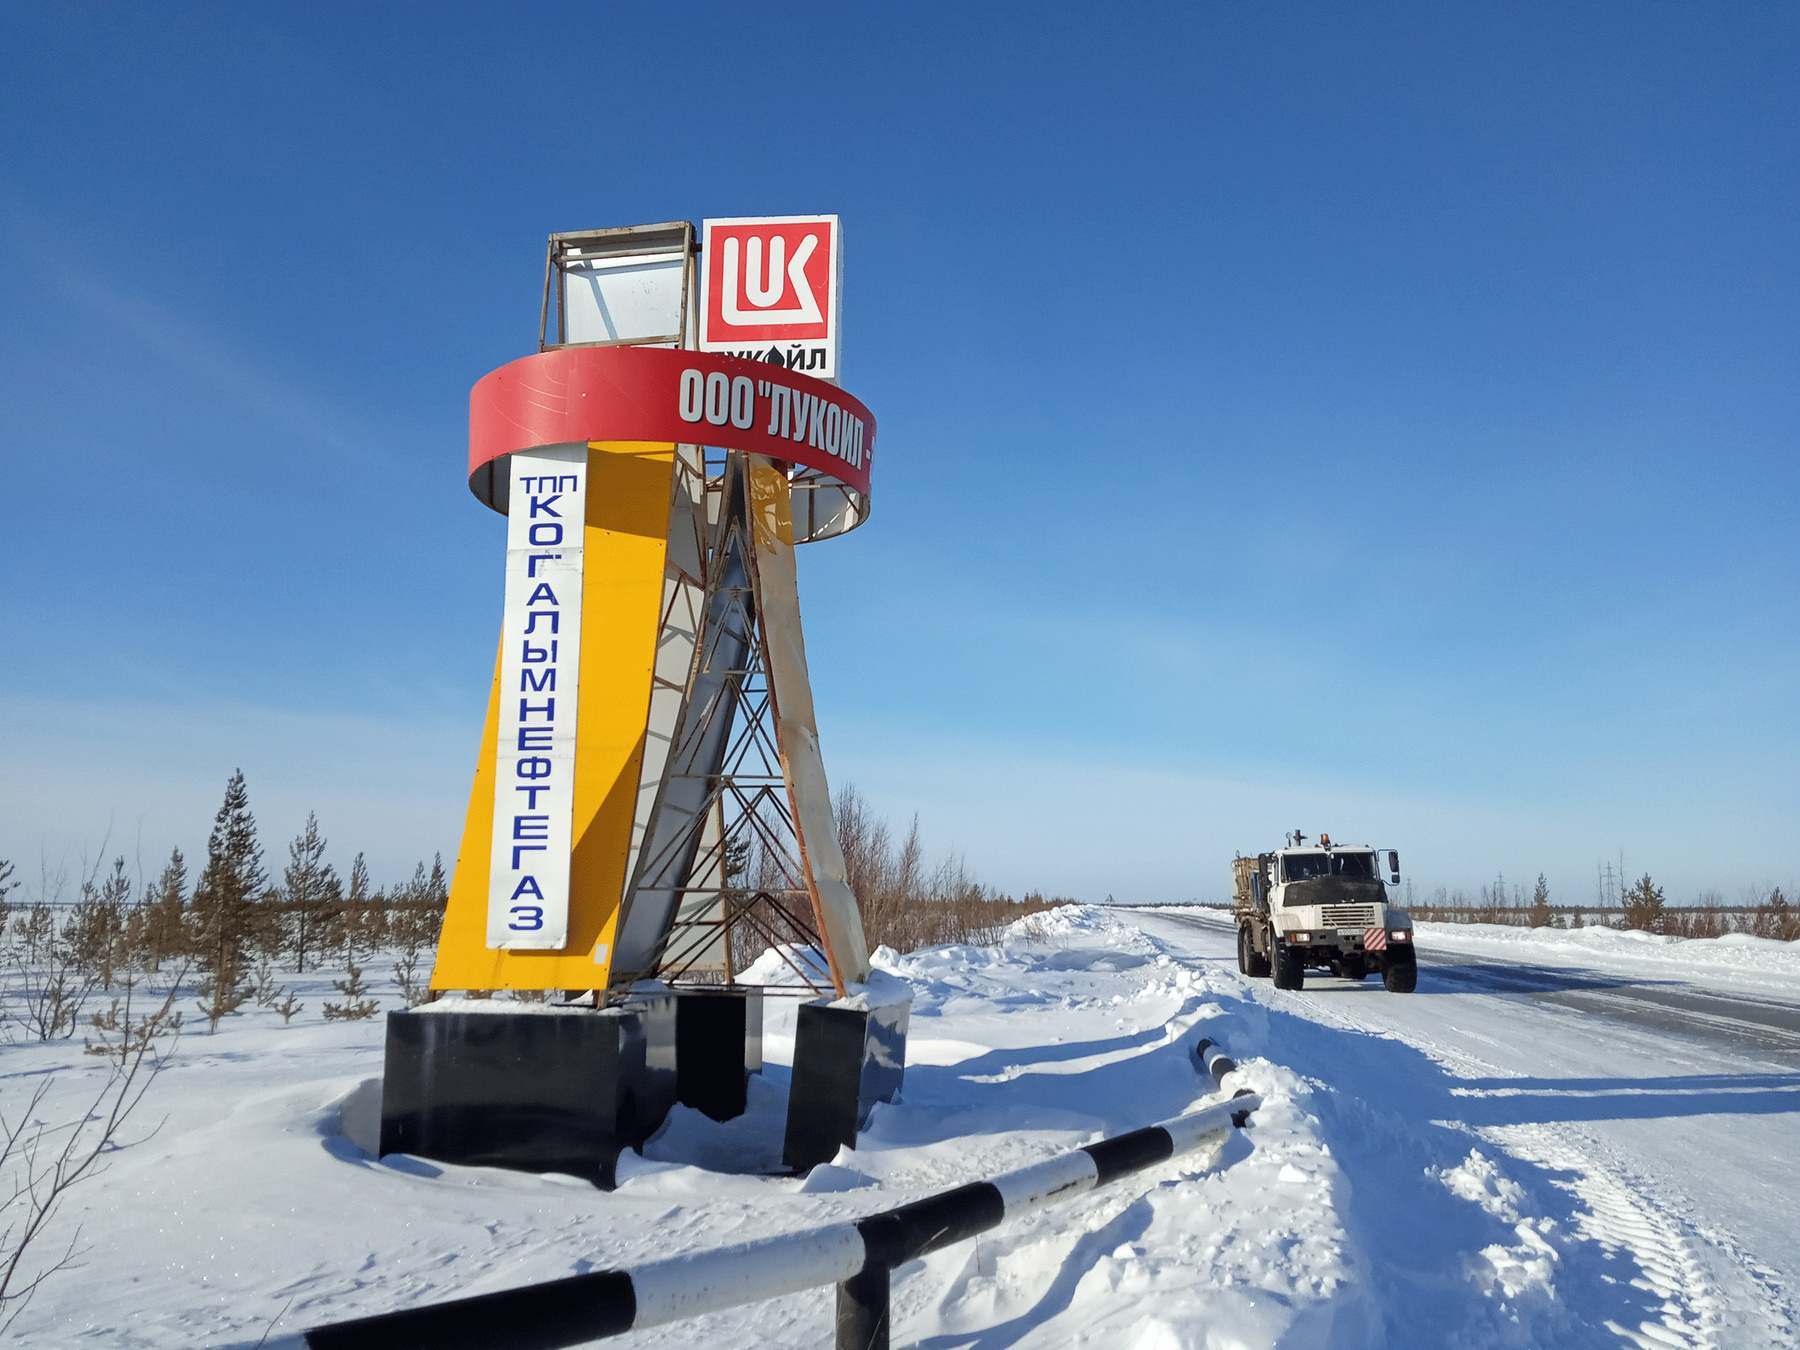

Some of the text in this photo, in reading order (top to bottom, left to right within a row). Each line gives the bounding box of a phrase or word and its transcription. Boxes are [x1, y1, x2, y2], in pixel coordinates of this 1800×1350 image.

[722, 234, 823, 326] LUK
[709, 344, 826, 370] ОЙЛ
[679, 369, 754, 430] ООО
[519, 475, 578, 494] ТПП
[508, 495, 563, 931] КОГАЛЫМНЕФТЕГАЗ
